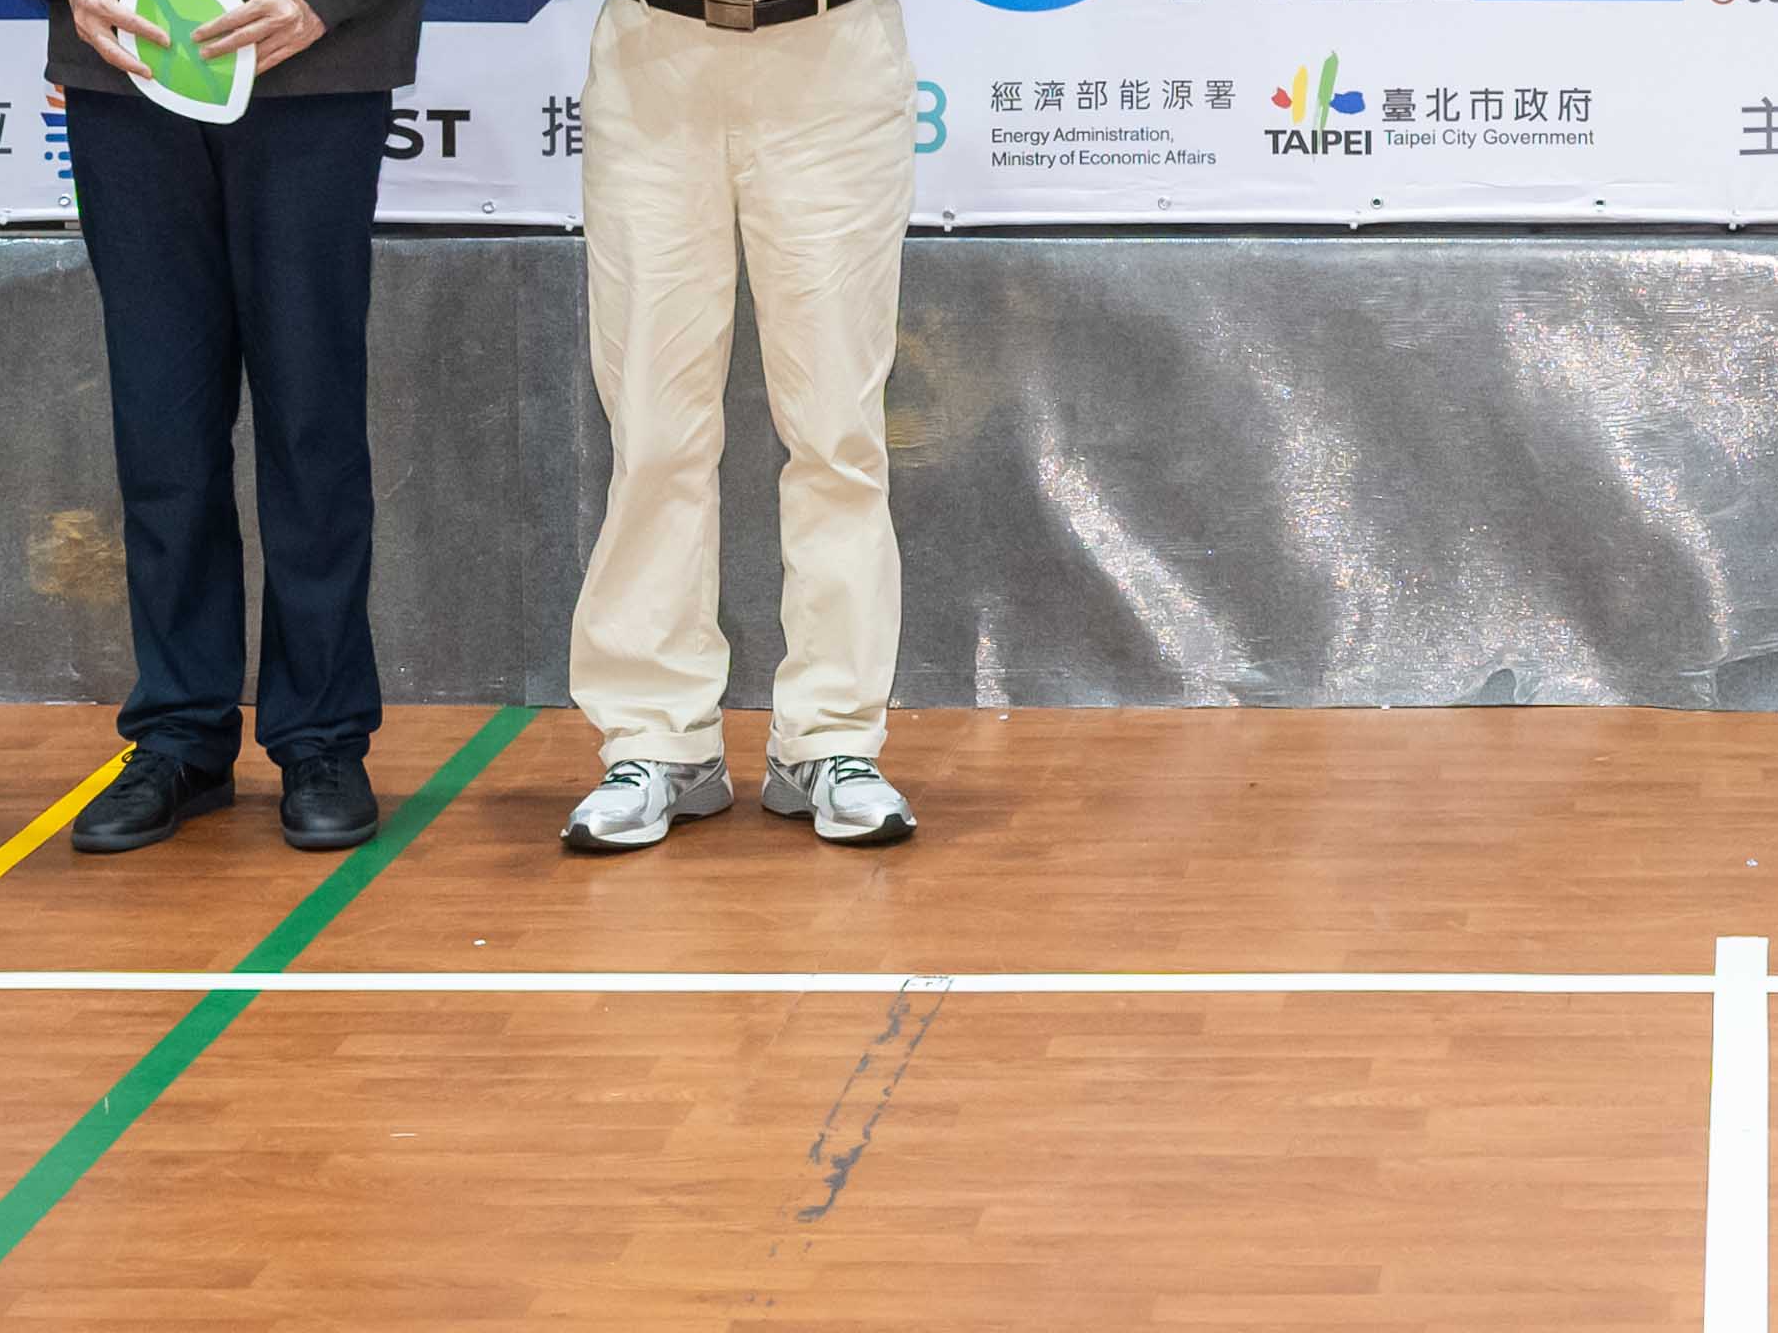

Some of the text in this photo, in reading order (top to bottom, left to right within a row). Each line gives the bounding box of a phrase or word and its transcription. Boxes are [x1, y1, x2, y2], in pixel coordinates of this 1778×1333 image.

[991, 79, 1236, 113] 經濟部能源署
[1381, 86, 1593, 124] 臺北市政府
[991, 126, 1175, 146] Energy Administration,
[1265, 129, 1373, 156] TAIPEI
[1385, 129, 1595, 151] Taipei City Government
[991, 148, 1217, 169] Ministry of Economic Affairs
